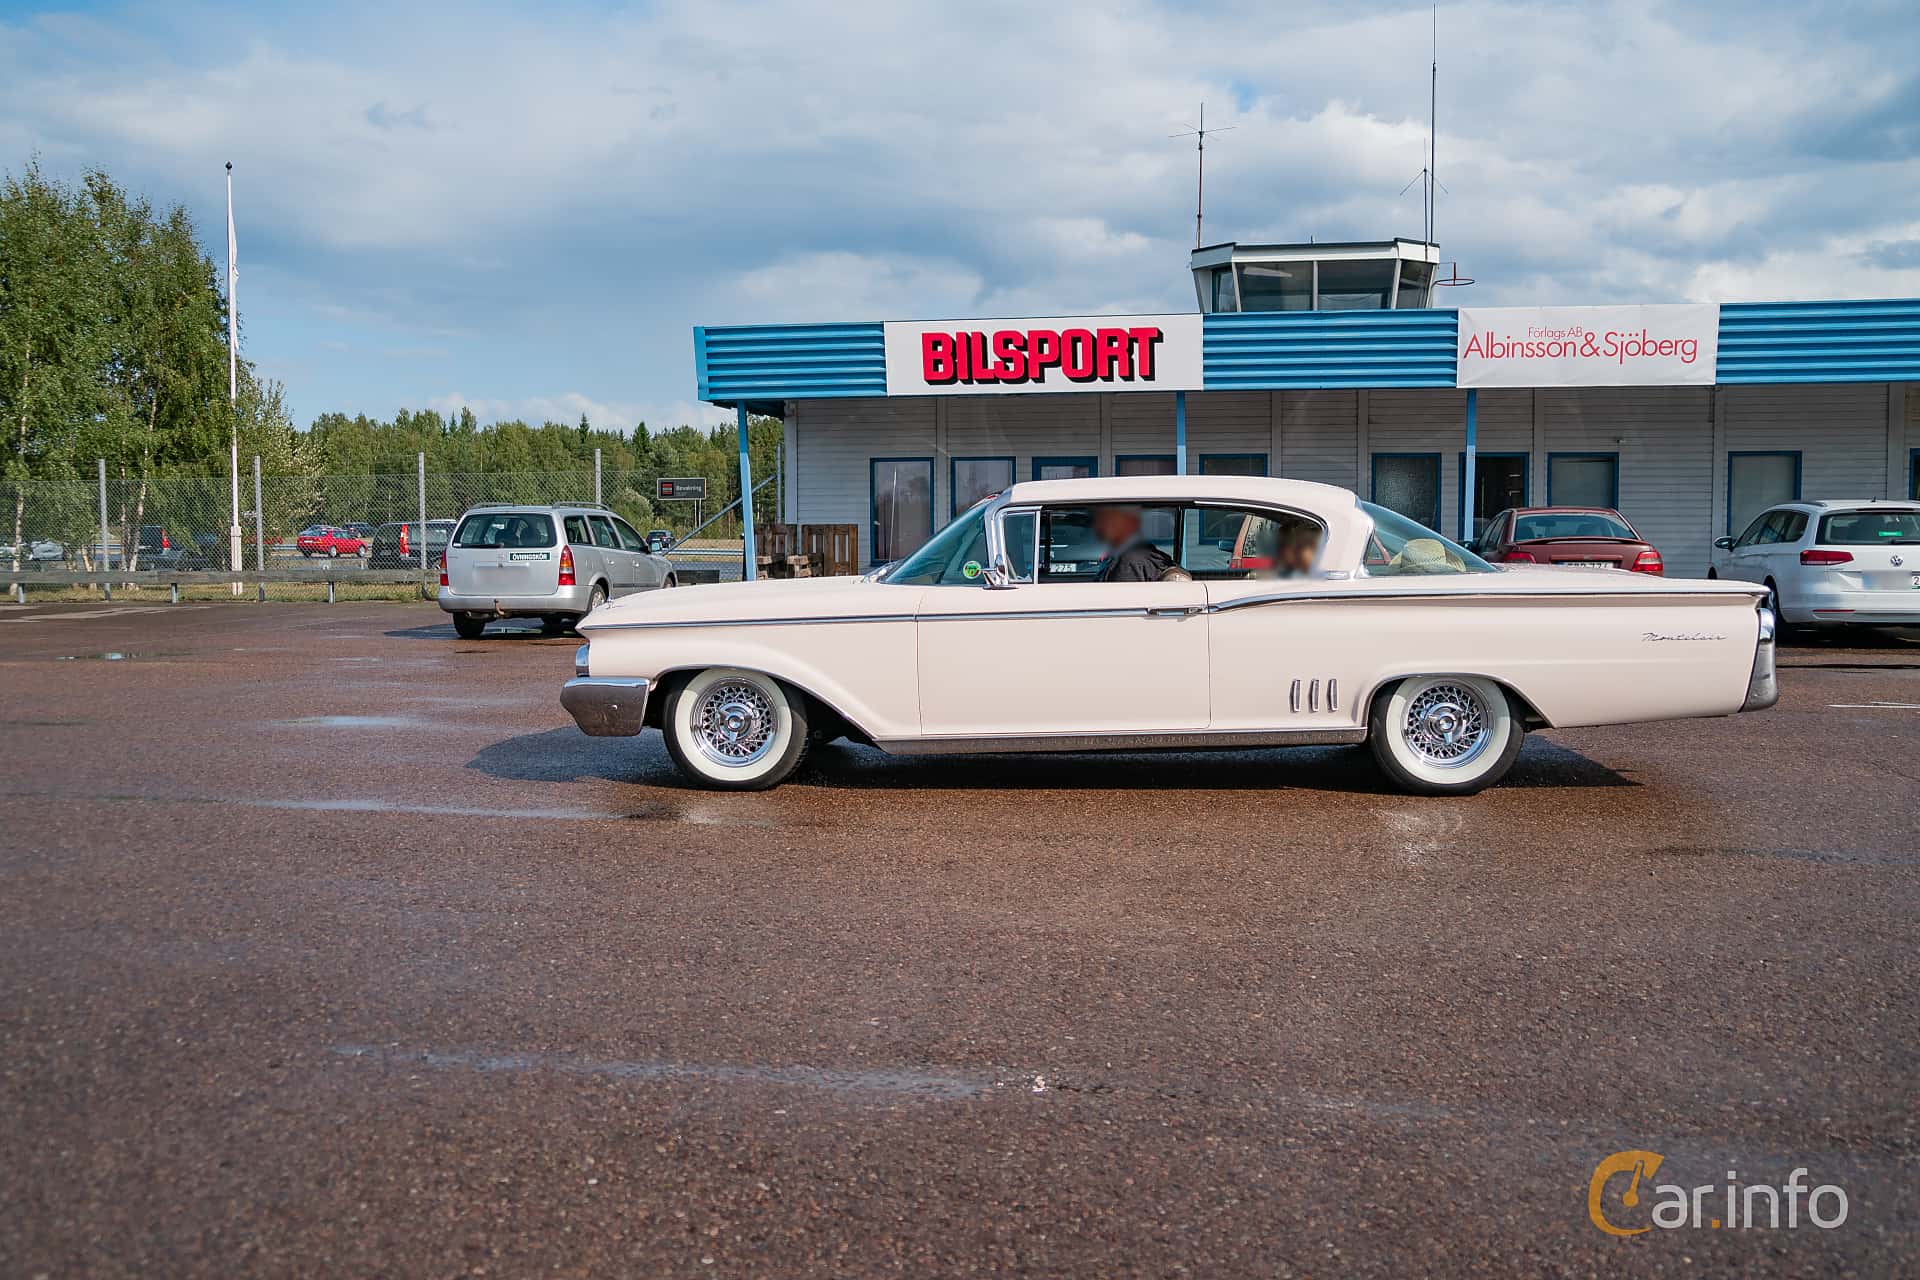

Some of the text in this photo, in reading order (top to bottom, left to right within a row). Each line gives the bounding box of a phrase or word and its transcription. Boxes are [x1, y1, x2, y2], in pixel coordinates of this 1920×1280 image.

[1528, 327, 1583, 339] Förlags AB
[1602, 329, 1698, 365] Sjöberg
[922, 327, 1163, 385] BILSPORT
